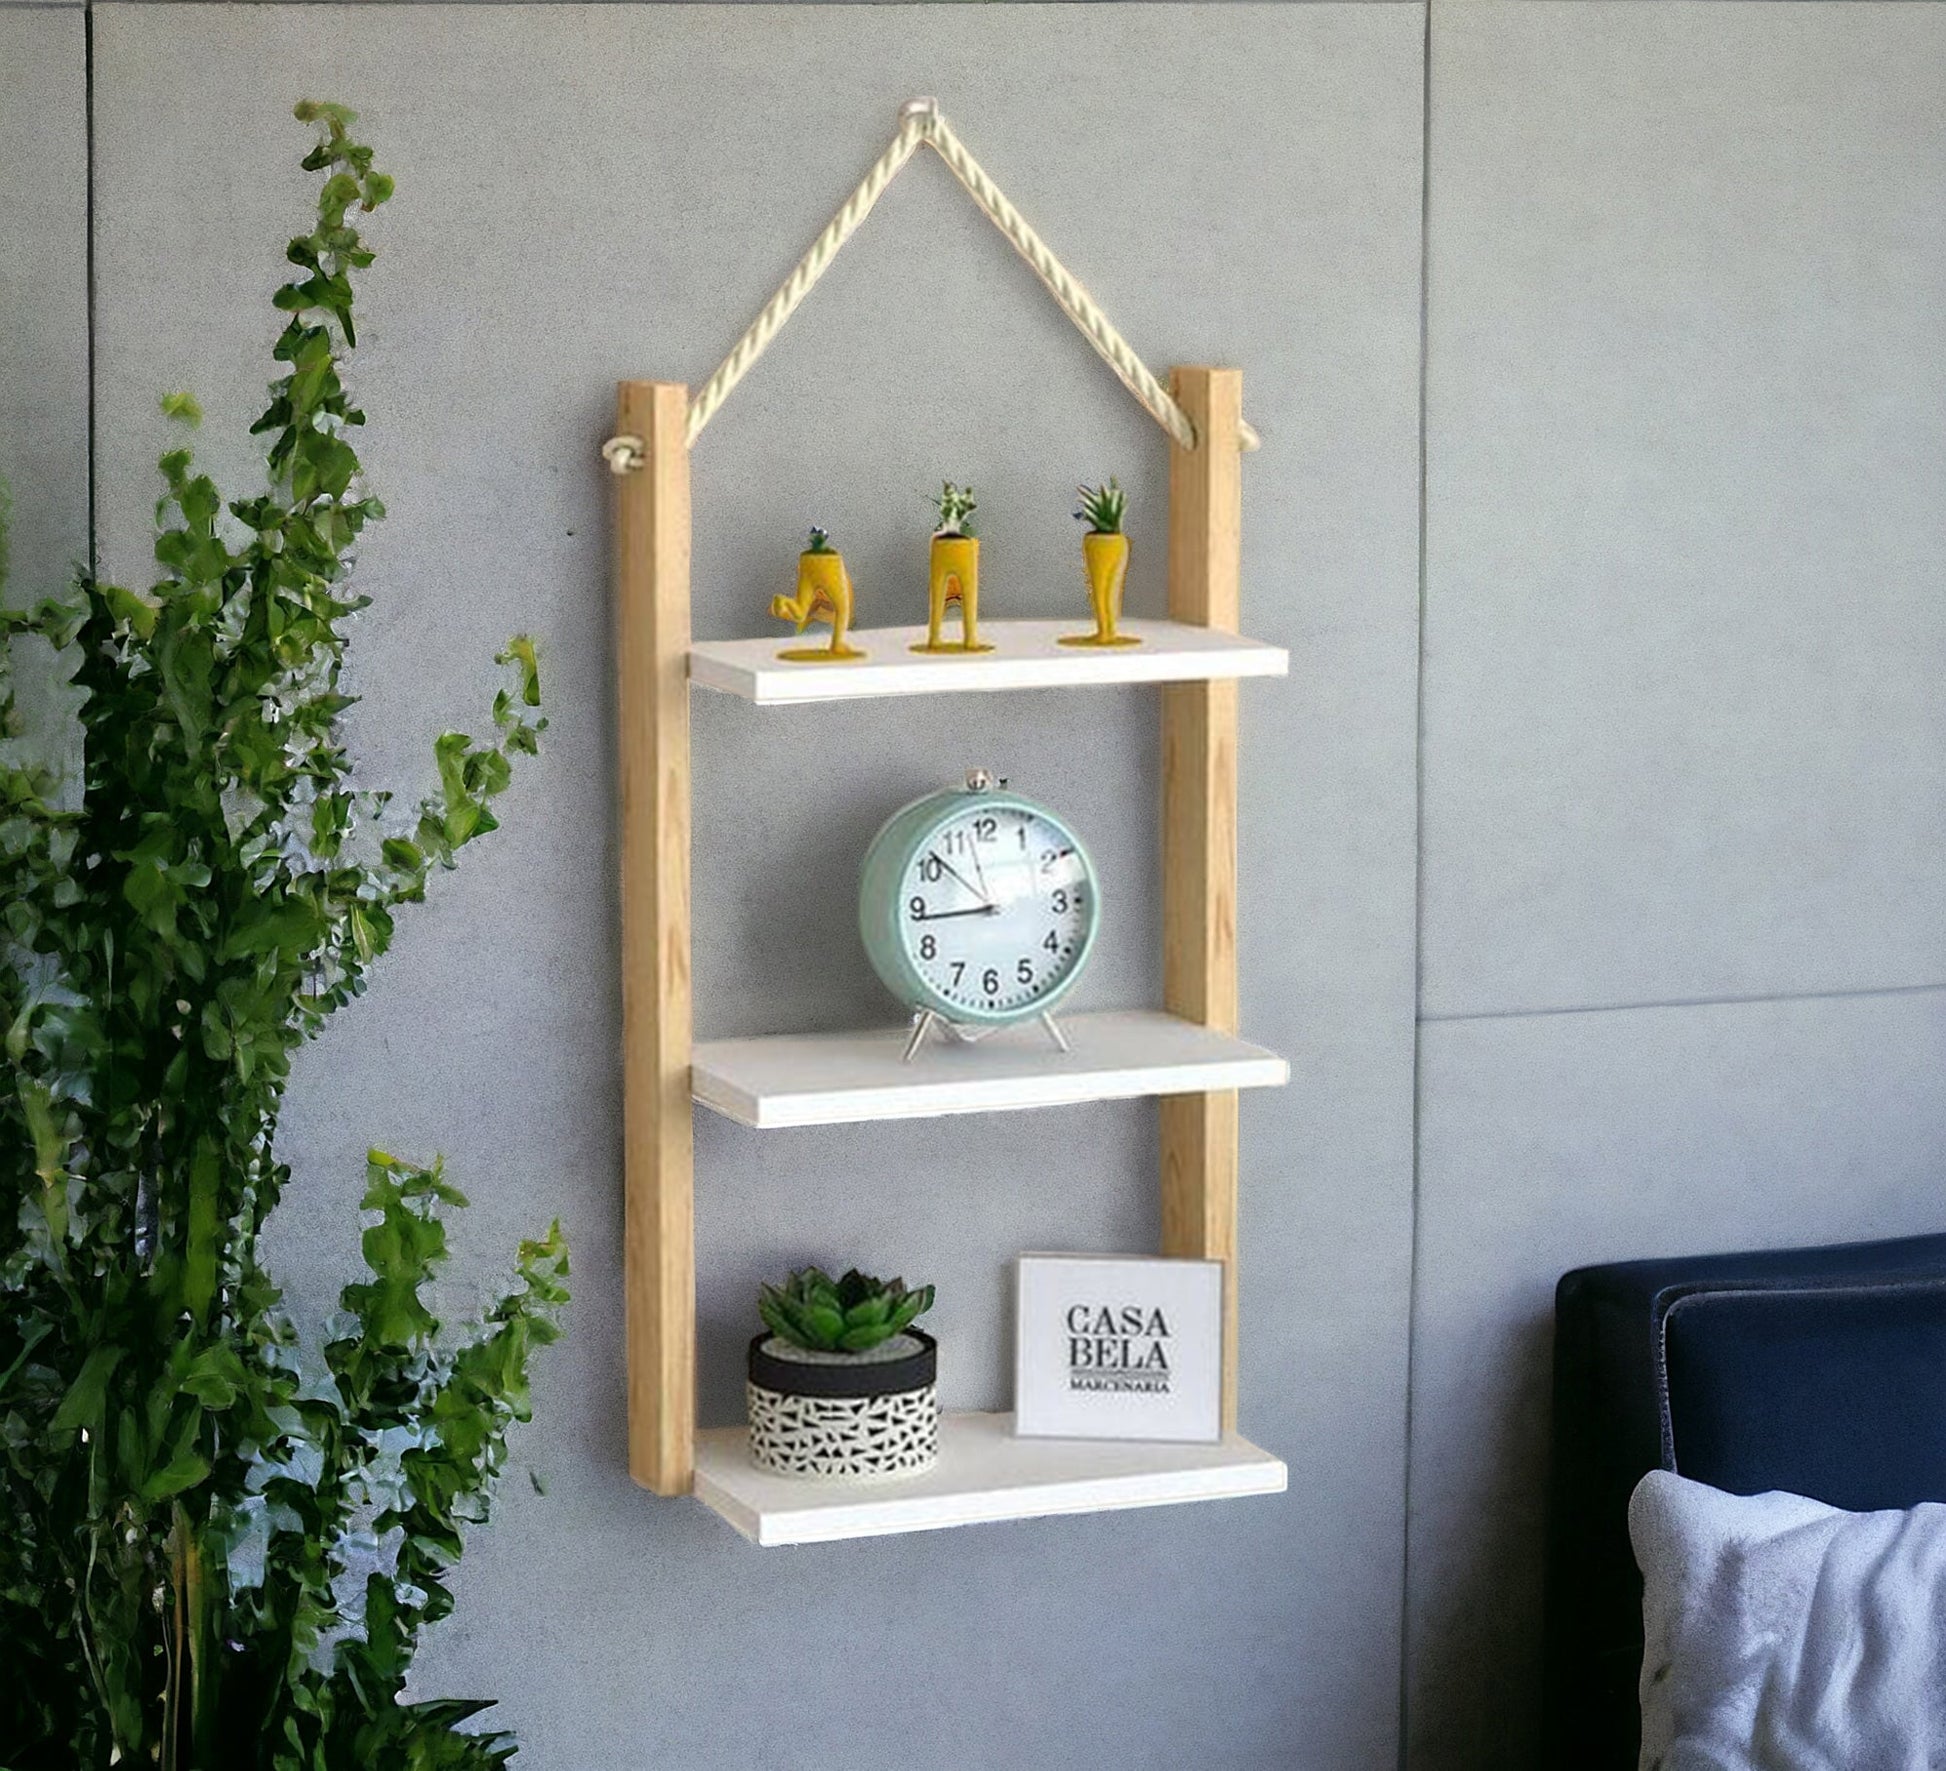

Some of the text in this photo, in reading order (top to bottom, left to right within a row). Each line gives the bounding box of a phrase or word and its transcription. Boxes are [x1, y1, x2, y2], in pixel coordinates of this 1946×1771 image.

[943, 831, 963, 854] 11
[973, 818, 997, 842] 12
[1017, 826, 1026, 850] 1
[918, 857, 942, 882] 10
[1040, 850, 1058, 874] 2
[910, 896, 926, 921] 9
[1051, 889, 1068, 914] 3
[920, 934, 936, 960] 8
[1043, 929, 1059, 954] 4
[950, 962, 966, 987] 7
[982, 969, 999, 995] 6
[1017, 958, 1034, 984] 5
[1067, 1304, 1170, 1337] CASA
[1069, 1337, 1169, 1369] BELA
